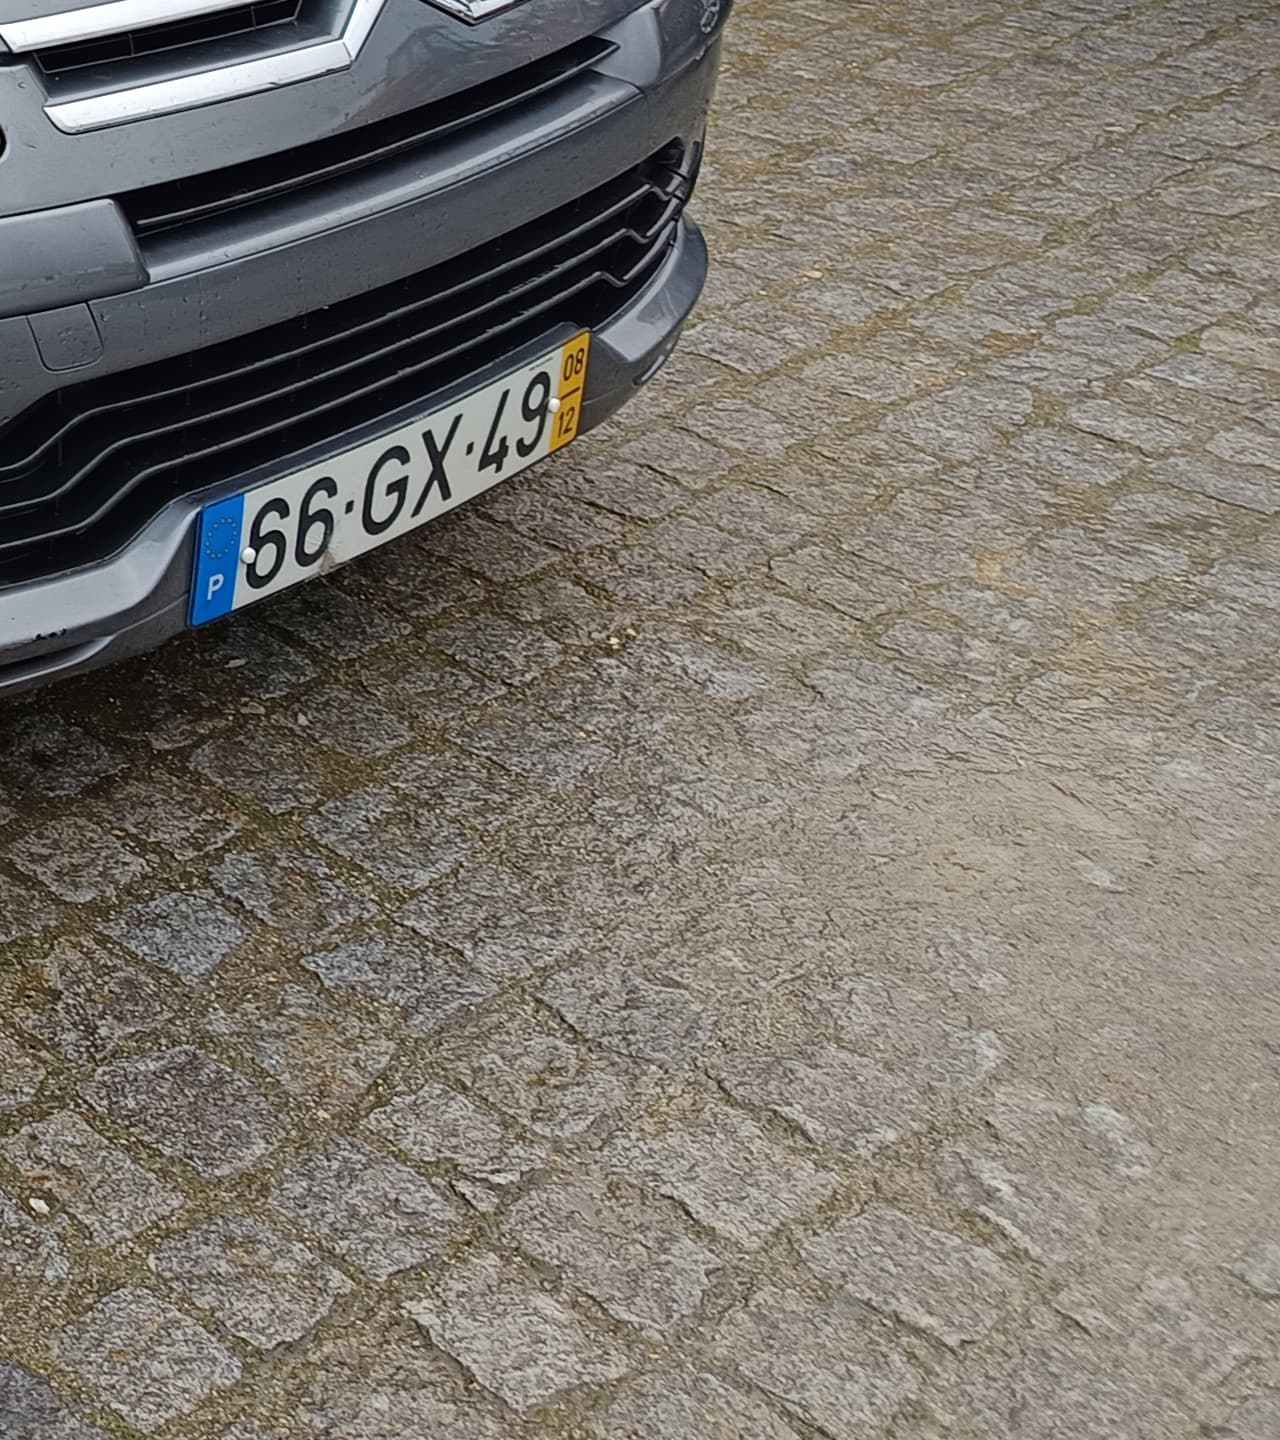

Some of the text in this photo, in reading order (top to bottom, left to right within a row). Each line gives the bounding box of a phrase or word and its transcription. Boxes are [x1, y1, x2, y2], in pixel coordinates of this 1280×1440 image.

[563, 347, 585, 381] 08
[558, 406, 576, 438] 12
[206, 573, 225, 601] P
